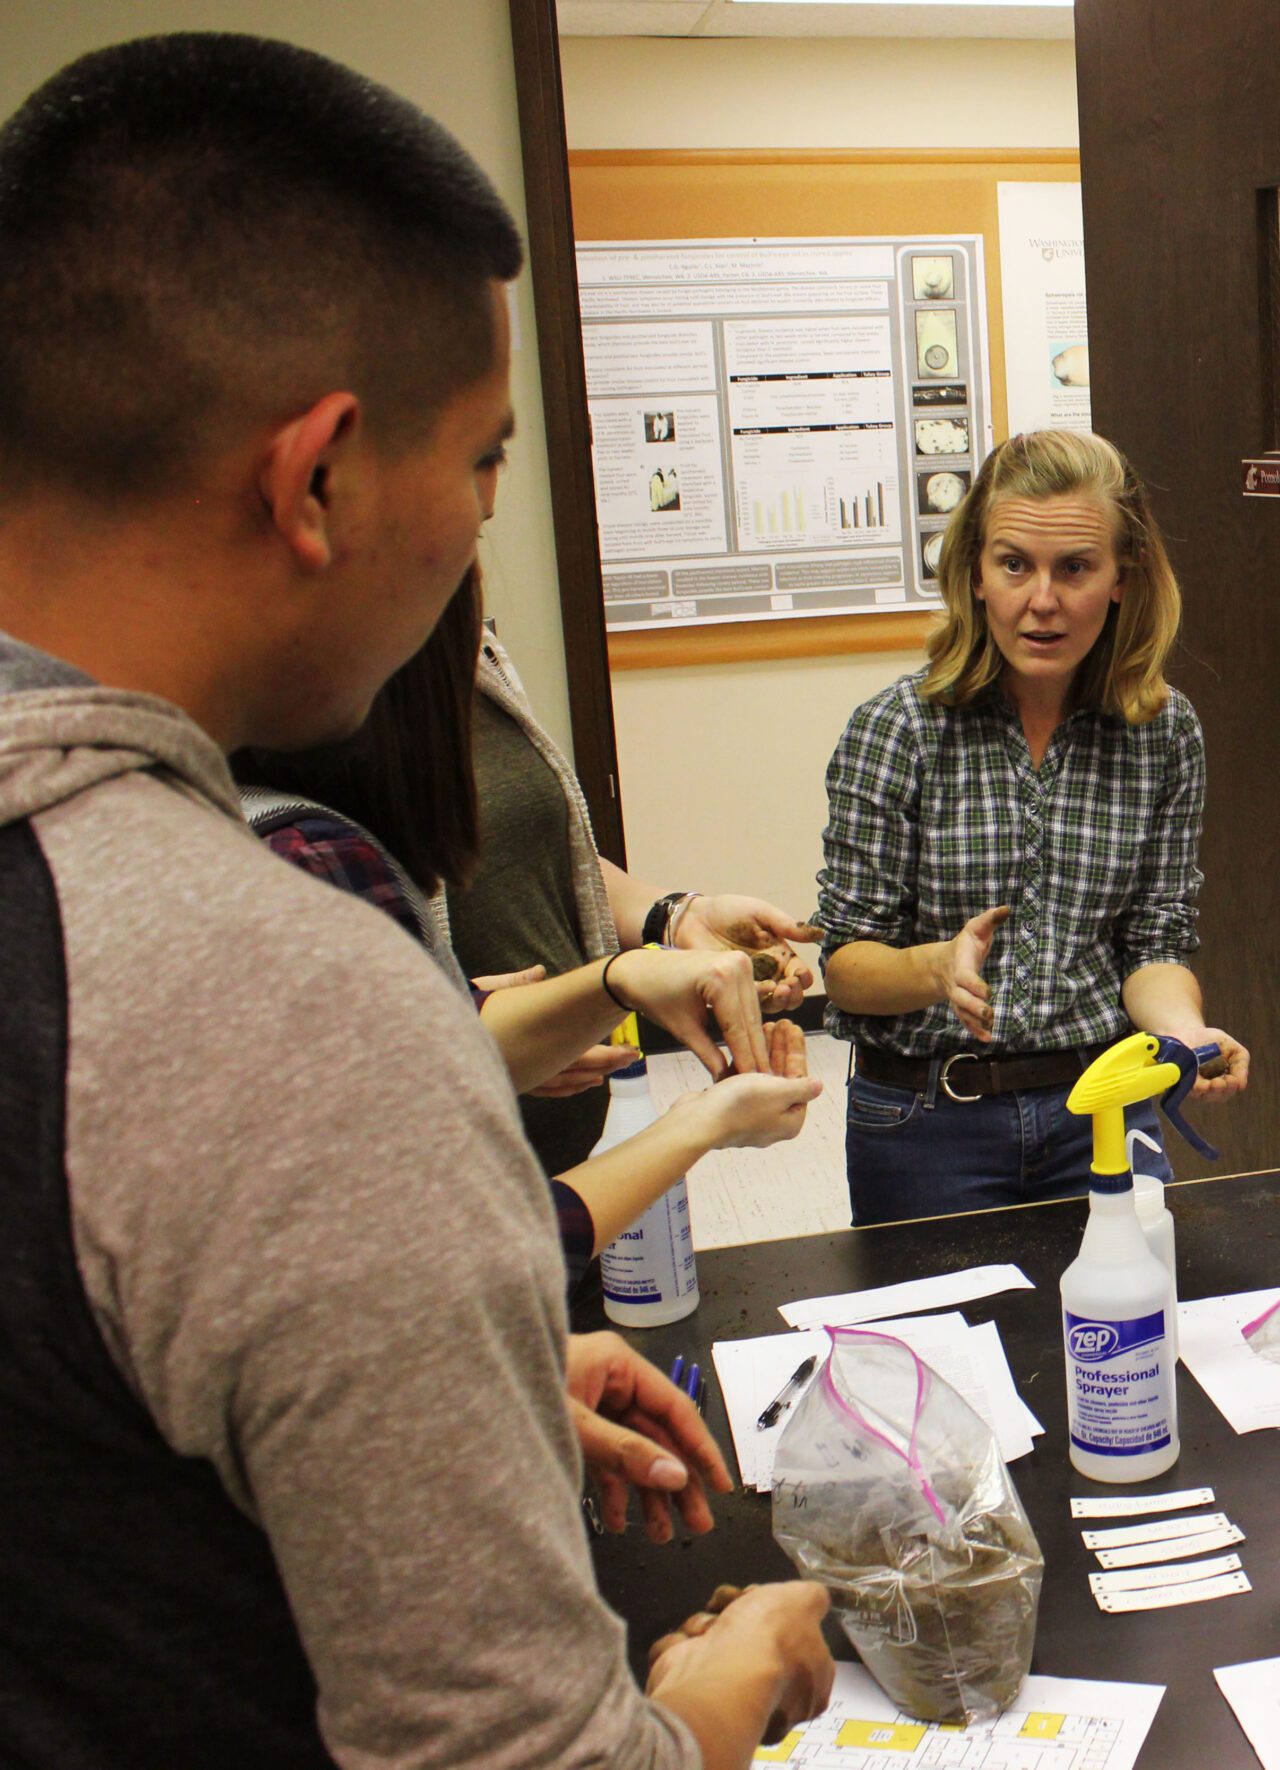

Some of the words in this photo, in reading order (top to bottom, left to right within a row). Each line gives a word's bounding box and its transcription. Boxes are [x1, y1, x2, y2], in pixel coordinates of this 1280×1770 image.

[1028, 239, 1084, 248] WASHINGTO
[1075, 1363, 1159, 1383] Professional
[1076, 1379, 1129, 1398] Sprayer
